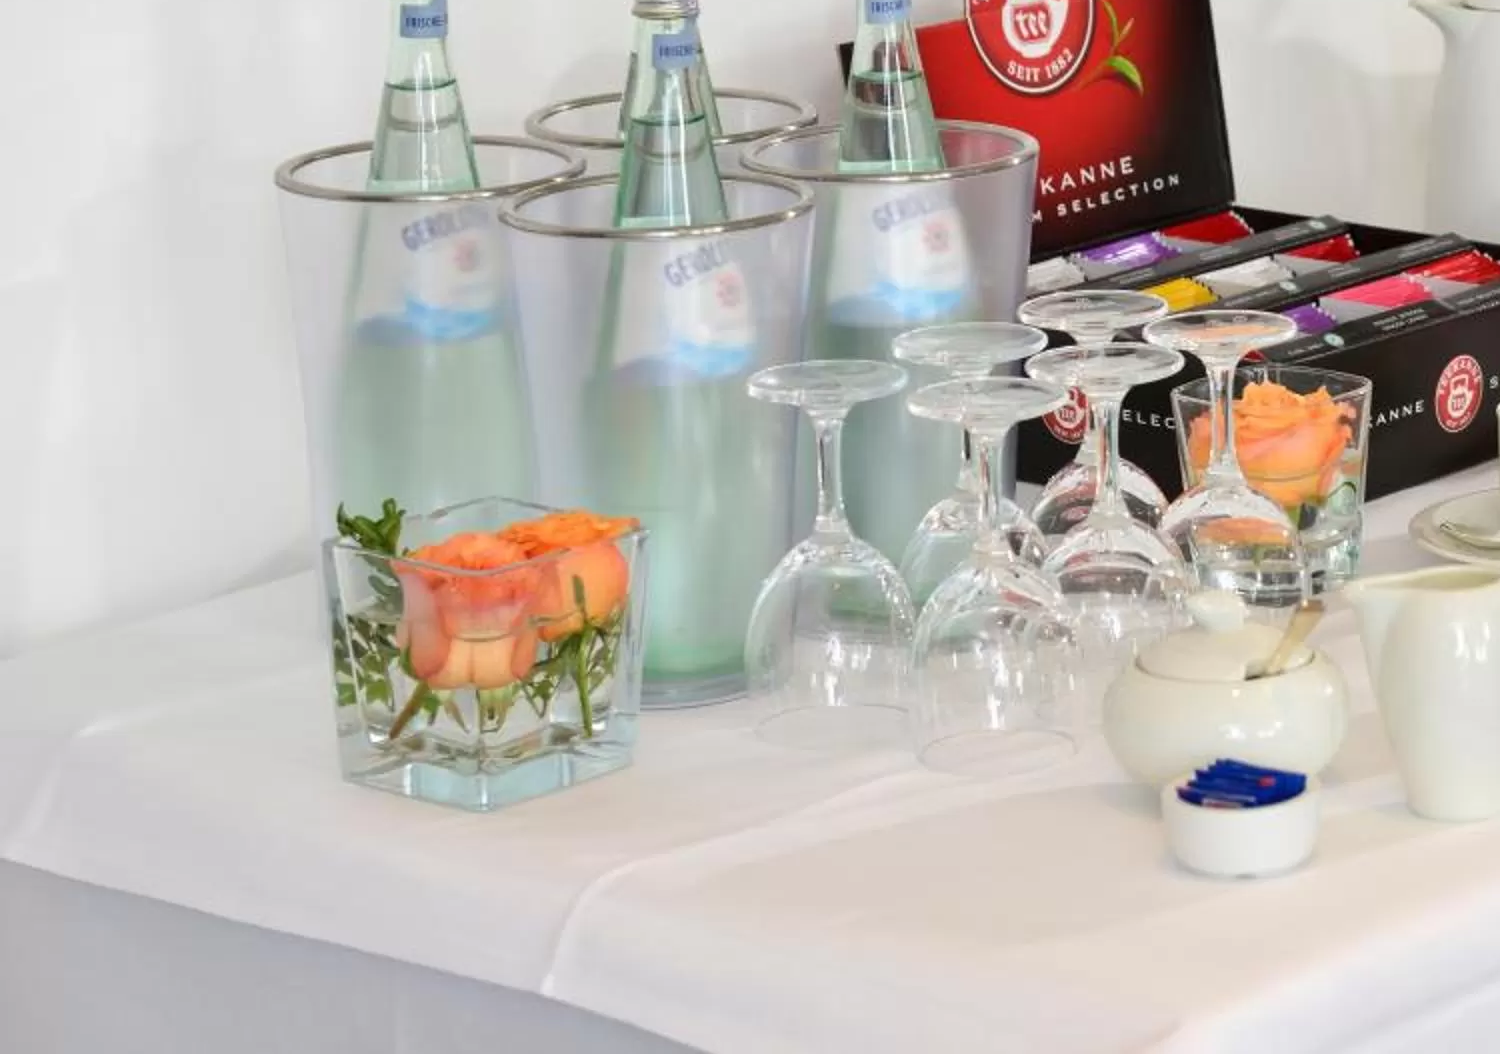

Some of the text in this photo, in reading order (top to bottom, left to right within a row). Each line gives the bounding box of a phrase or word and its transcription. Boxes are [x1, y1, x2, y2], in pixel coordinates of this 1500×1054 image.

[1007, 47, 1074, 83] SEIT 1882
[1056, 174, 1180, 218] SELECTION
